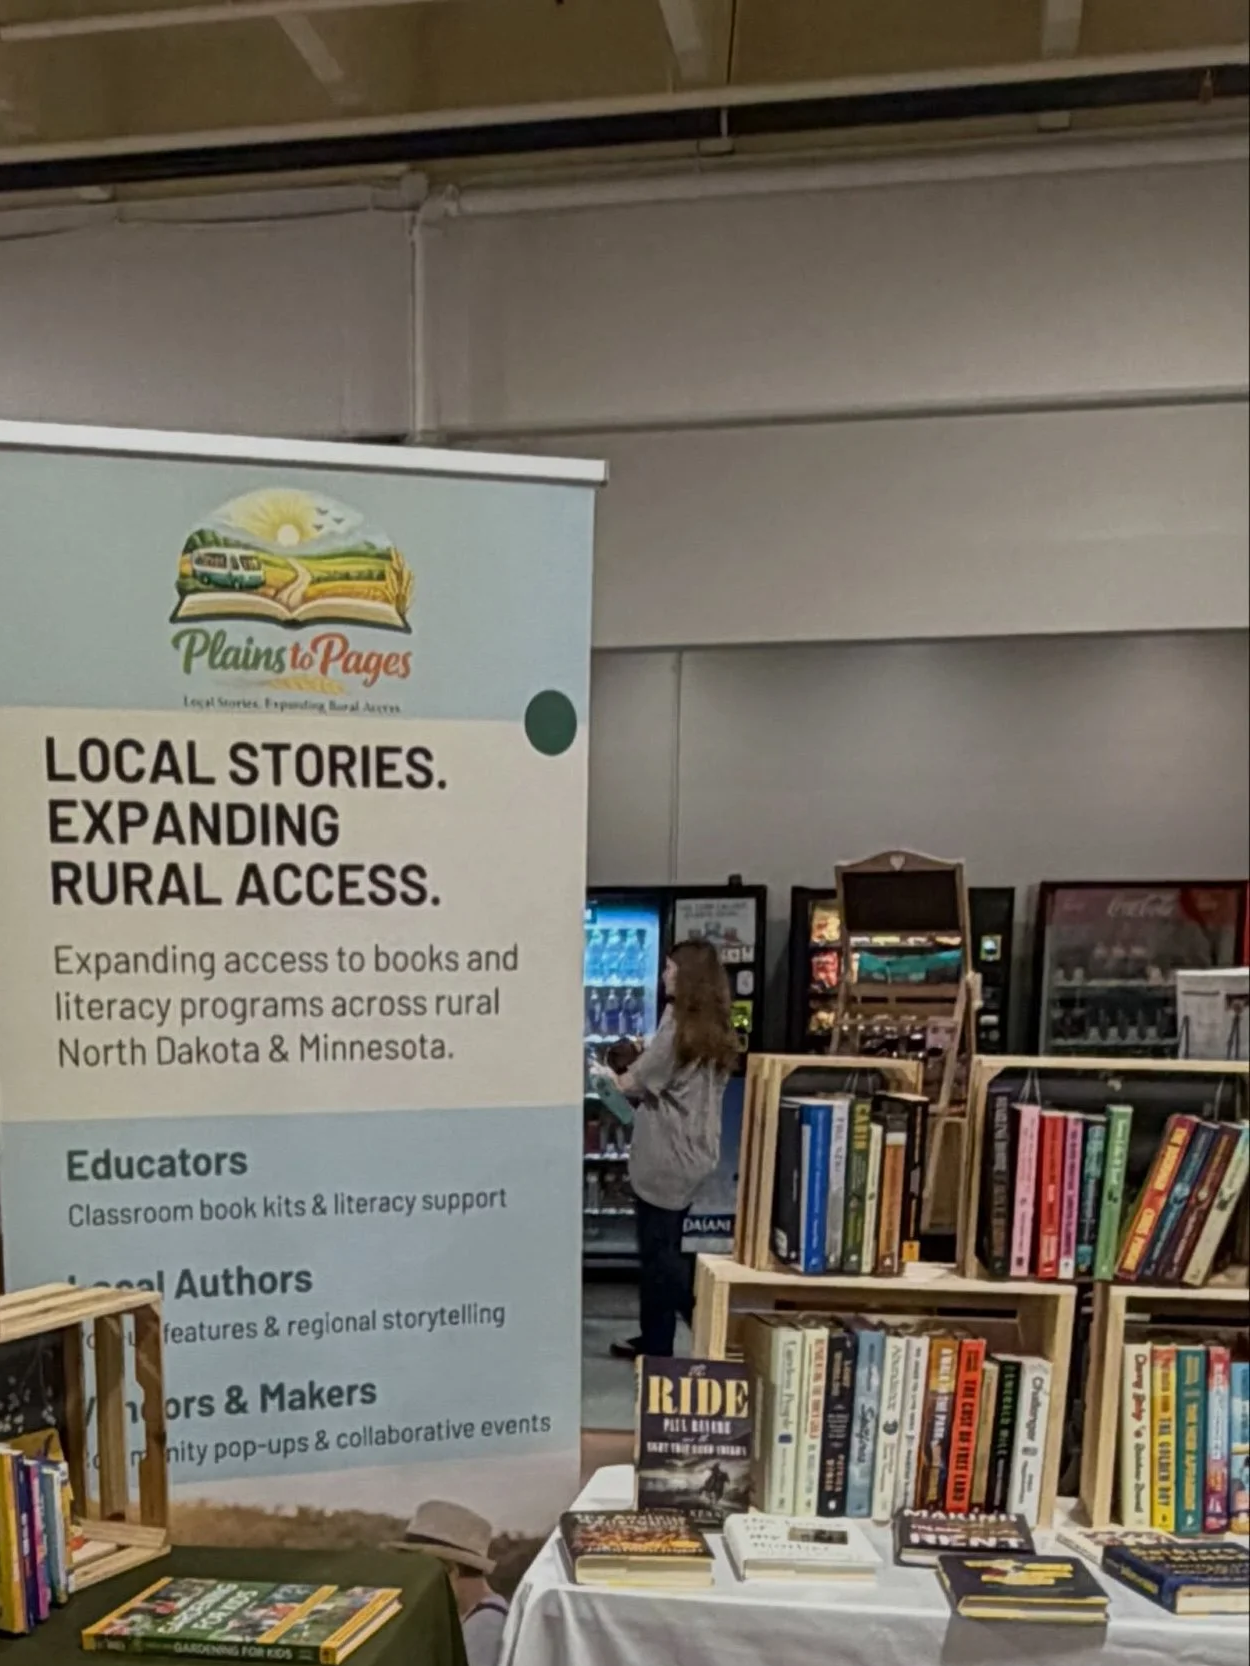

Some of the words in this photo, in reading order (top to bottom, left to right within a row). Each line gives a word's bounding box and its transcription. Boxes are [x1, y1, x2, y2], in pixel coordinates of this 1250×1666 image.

[171, 628, 287, 675] Plains
[289, 642, 314, 671] to
[310, 632, 413, 688] Pages
[46, 735, 215, 784] LOCAL
[229, 741, 448, 790] STORIES.
[49, 799, 340, 847] EXPANDING
[51, 861, 222, 906] RURAL
[236, 862, 441, 907] ACCESS.
[54, 944, 216, 981] Expanding
[223, 950, 328, 973] access
[336, 945, 366, 973] to
[374, 941, 459, 973] books
[467, 941, 519, 971] and
[55, 991, 172, 1026] literacy
[179, 996, 324, 1026] programs
[331, 994, 428, 1018] across
[435, 988, 499, 1016] rural
[57, 1036, 147, 1069] North
[156, 1034, 260, 1066] Dakota
[268, 1034, 290, 1064] &
[299, 1032, 454, 1064] Minnesota.
[66, 1145, 249, 1184] Educators
[68, 1201, 193, 1229] Classroom
[199, 1197, 257, 1223] book
[263, 1194, 305, 1220] kits
[312, 1193, 328, 1217] &
[333, 1190, 416, 1221] literacy
[421, 1187, 507, 1216] support
[174, 1264, 314, 1300] Authors
[163, 1320, 258, 1345] features
[263, 1315, 281, 1338] &
[287, 1309, 377, 1339] regional
[382, 1302, 506, 1331] storytelling
[224, 1384, 249, 1415] &
[259, 1377, 377, 1414] Makers
[646, 1375, 750, 1419] RIDE
[214, 1434, 309, 1463] pop-ups
[315, 1429, 330, 1451] &
[336, 1418, 475, 1452] collaborative
[480, 1413, 551, 1437] events
[173, 1642, 240, 1657] GARDENING
[241, 1644, 264, 1658] FOR
[266, 1646, 293, 1660] KIDS
